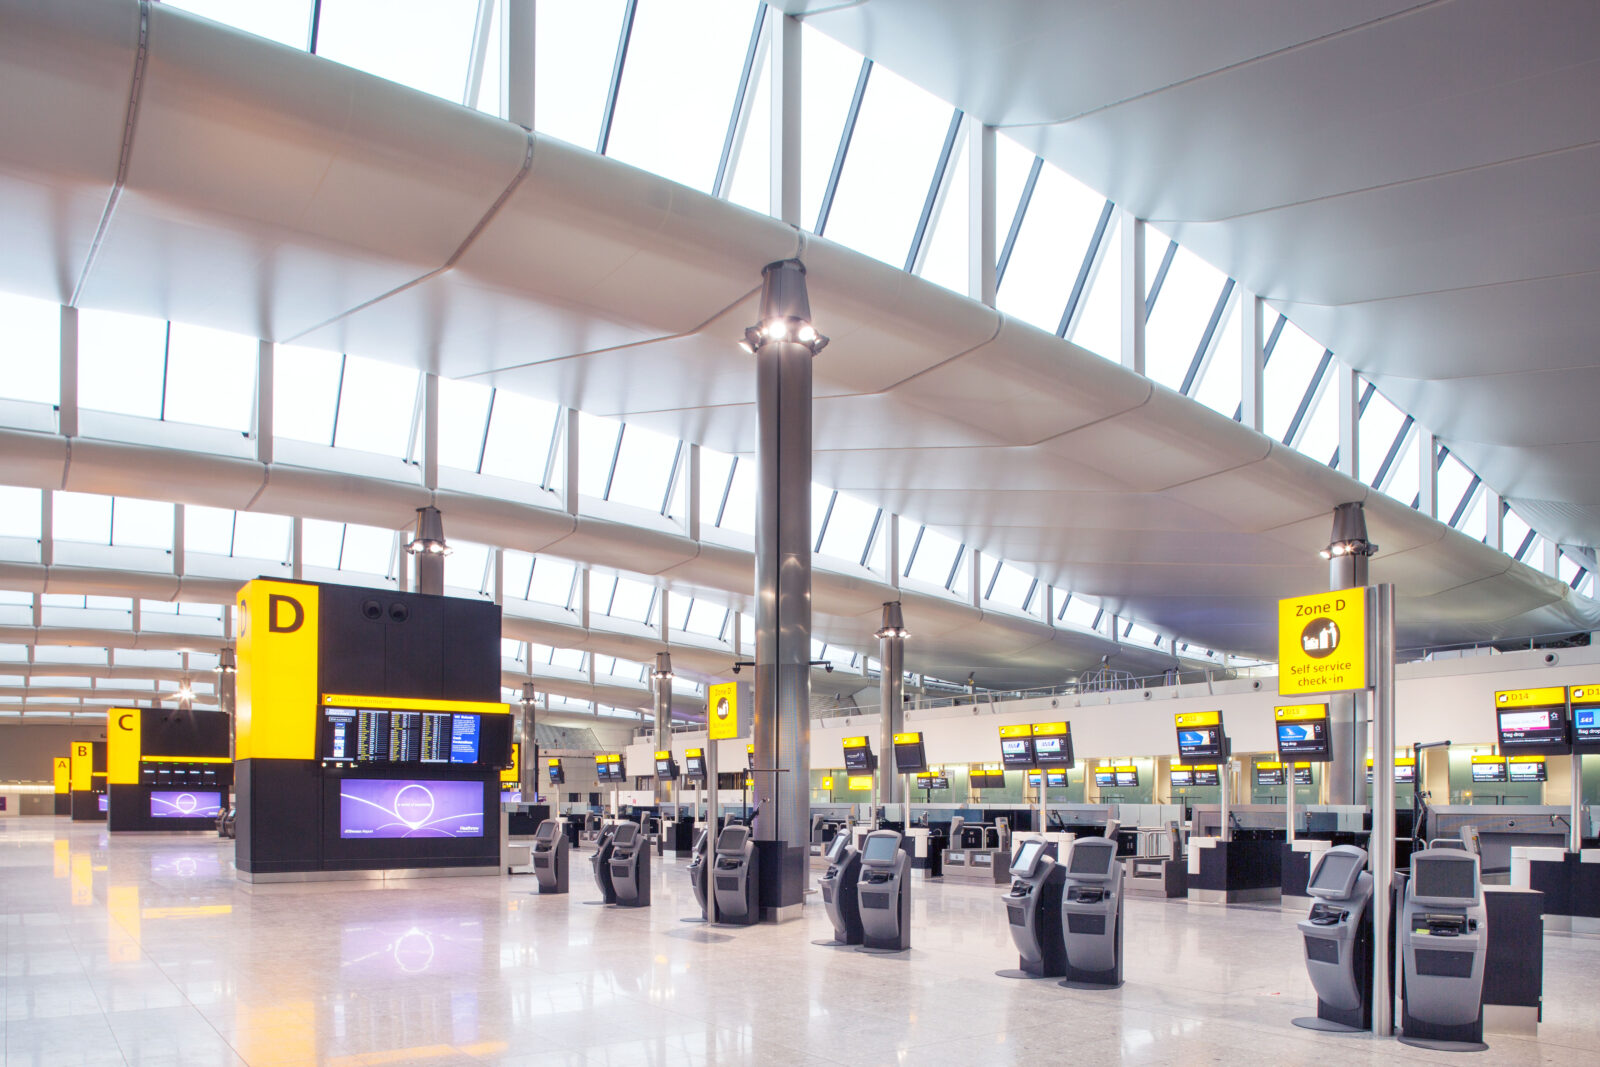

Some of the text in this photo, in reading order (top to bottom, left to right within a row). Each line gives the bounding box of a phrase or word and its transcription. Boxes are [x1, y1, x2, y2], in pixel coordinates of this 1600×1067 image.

[269, 594, 304, 633] D
[1295, 599, 1346, 617] Zone D
[240, 600, 247, 638] D
[1290, 661, 1352, 675] Self service
[1298, 674, 1344, 687] check-in
[1511, 693, 1529, 701] D14
[118, 714, 133, 731] C
[78, 746, 87, 756] B
